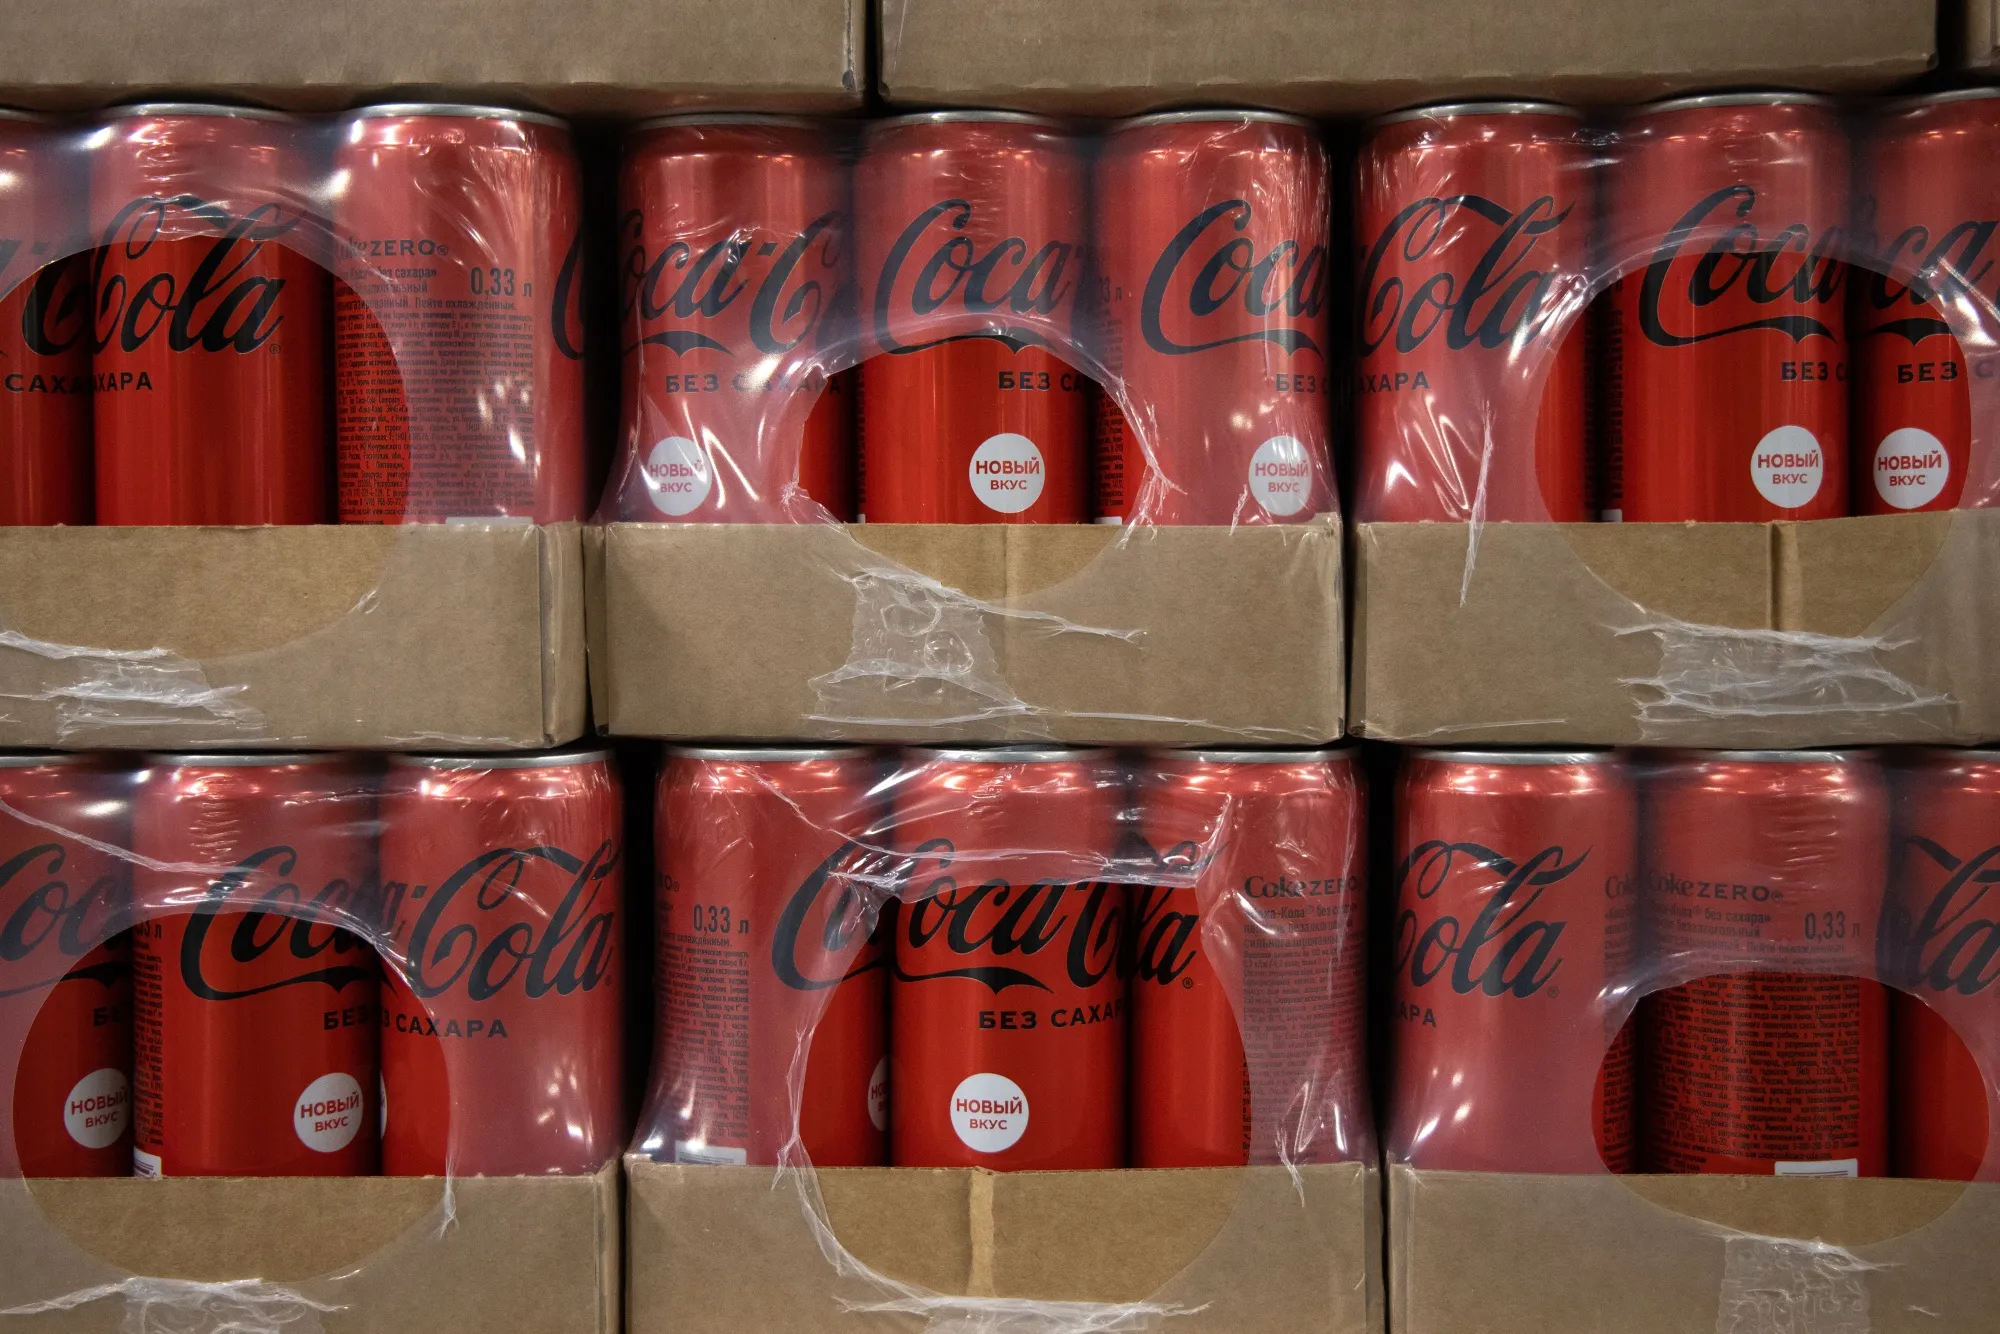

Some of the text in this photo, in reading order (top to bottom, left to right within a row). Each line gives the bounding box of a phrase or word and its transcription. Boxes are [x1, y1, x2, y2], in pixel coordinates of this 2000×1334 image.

[470, 266, 532, 298] 0,33 л
[998, 371, 1050, 391] БЕЗ
[1781, 361, 1829, 382] БЕЗ
[1896, 361, 1958, 384] БЕЗ
[93, 371, 152, 393] ХАРА
[665, 373, 719, 393] БЕЗ
[1275, 373, 1317, 394] БЕЗ
[975, 456, 1040, 475] НОВЫЙ
[1254, 460, 1309, 477] НОВЫЙ
[1757, 449, 1819, 469] НОВЫЙ
[1877, 450, 1942, 472] НОВЫЙ
[660, 482, 693, 493] ВКУС
[990, 479, 1027, 491] ВКУС
[1267, 481, 1300, 493] ВКУС
[1772, 473, 1807, 485] ВКУС
[1889, 474, 1926, 487] ВКУС
[693, 903, 731, 936] 0,33
[738, 919, 749, 934] л
[1804, 911, 1846, 942] 0,33
[396, 1013, 508, 1038] САХАРА
[979, 1010, 1037, 1031] БЕЗ
[70, 1085, 129, 1116] НОВЫЙ
[300, 1090, 360, 1119] НОВЫЙ
[956, 1096, 1023, 1115] НОВЫЙ
[85, 1110, 121, 1129] ВКУС
[314, 1116, 349, 1133] ВКУС
[969, 1118, 1008, 1131] ВКУС
